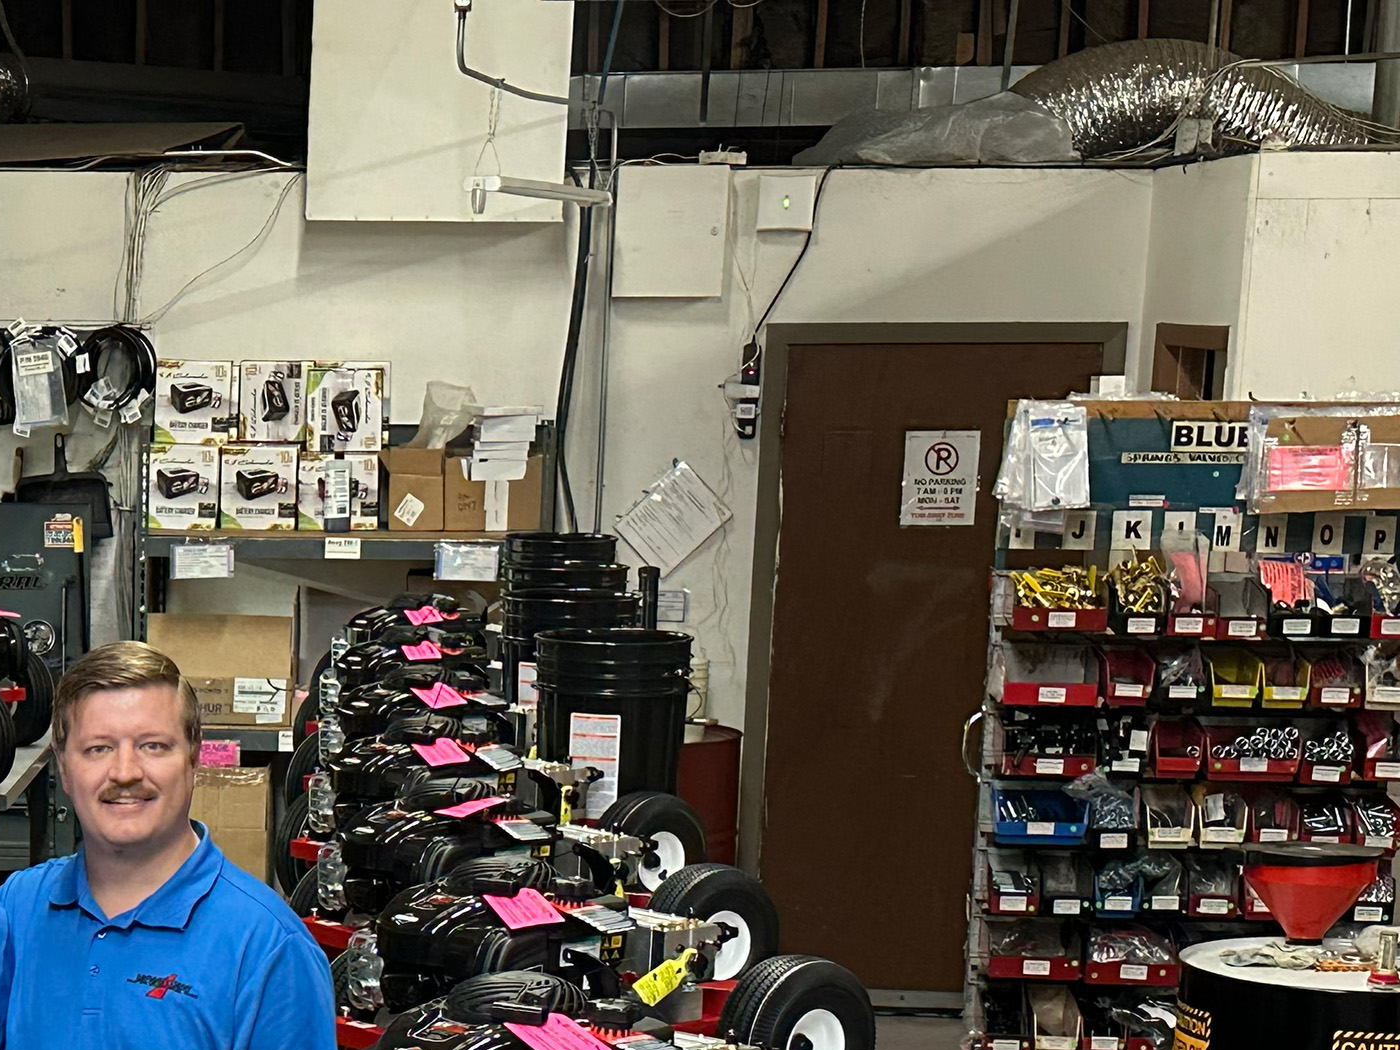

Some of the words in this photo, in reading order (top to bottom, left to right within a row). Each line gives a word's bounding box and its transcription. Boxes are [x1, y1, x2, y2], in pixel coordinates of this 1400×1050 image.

[1173, 425, 1248, 448] BLUE
[914, 478, 927, 486] NO
[928, 478, 966, 486] PARKING
[1071, 520, 1086, 540] J
[1125, 520, 1142, 540] K
[1215, 525, 1232, 547] M
[1264, 526, 1279, 548] N
[1320, 524, 1334, 546] O
[1374, 529, 1387, 551] P
